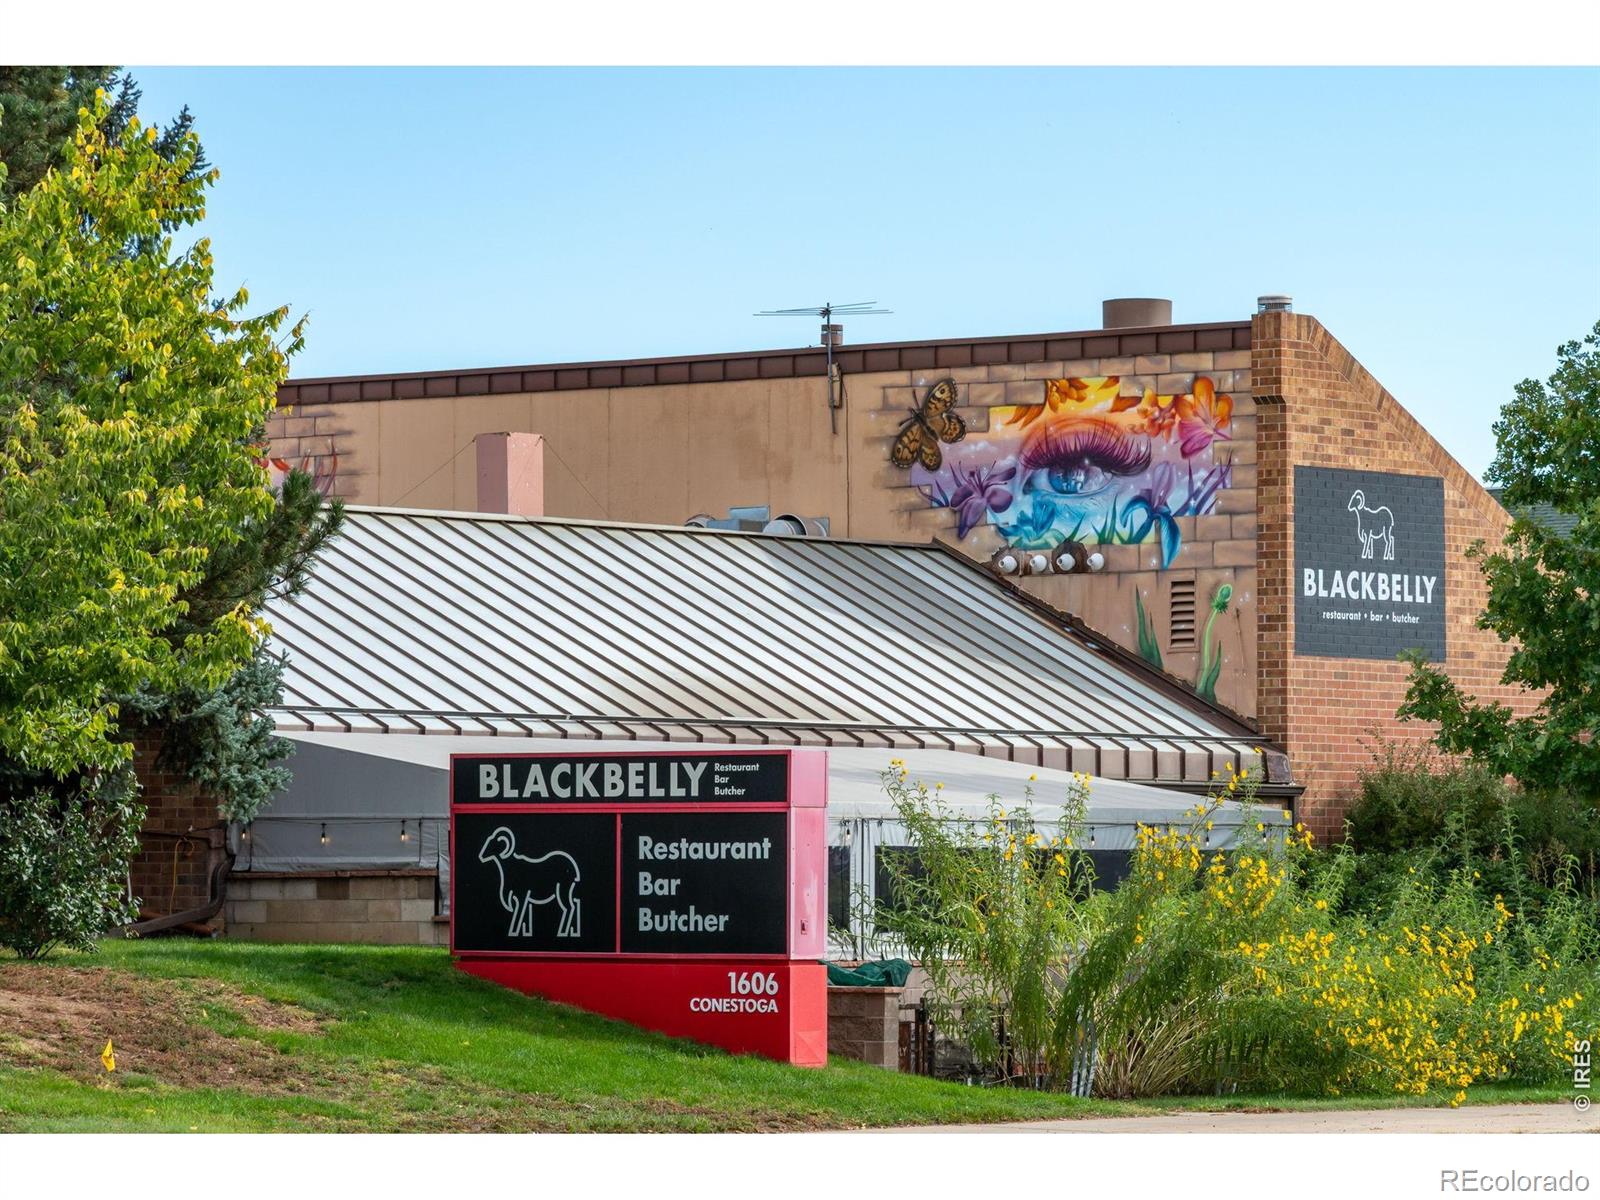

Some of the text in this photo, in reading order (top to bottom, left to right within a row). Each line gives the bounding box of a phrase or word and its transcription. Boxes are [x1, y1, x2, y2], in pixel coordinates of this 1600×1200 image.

[1303, 568, 1437, 604] BLACKBELLY
[1322, 610, 1420, 624] restaurant bar butcher
[714, 762, 760, 772] Restaurant
[478, 762, 708, 798] BLACKBELLY
[714, 775, 730, 784] Bar
[714, 786, 746, 796] Butcher
[638, 836, 771, 860] Restaurant
[638, 872, 681, 896] Bar
[638, 905, 729, 932] Butcher
[727, 971, 779, 996] 1606
[689, 997, 779, 1013] CONESTOGA
